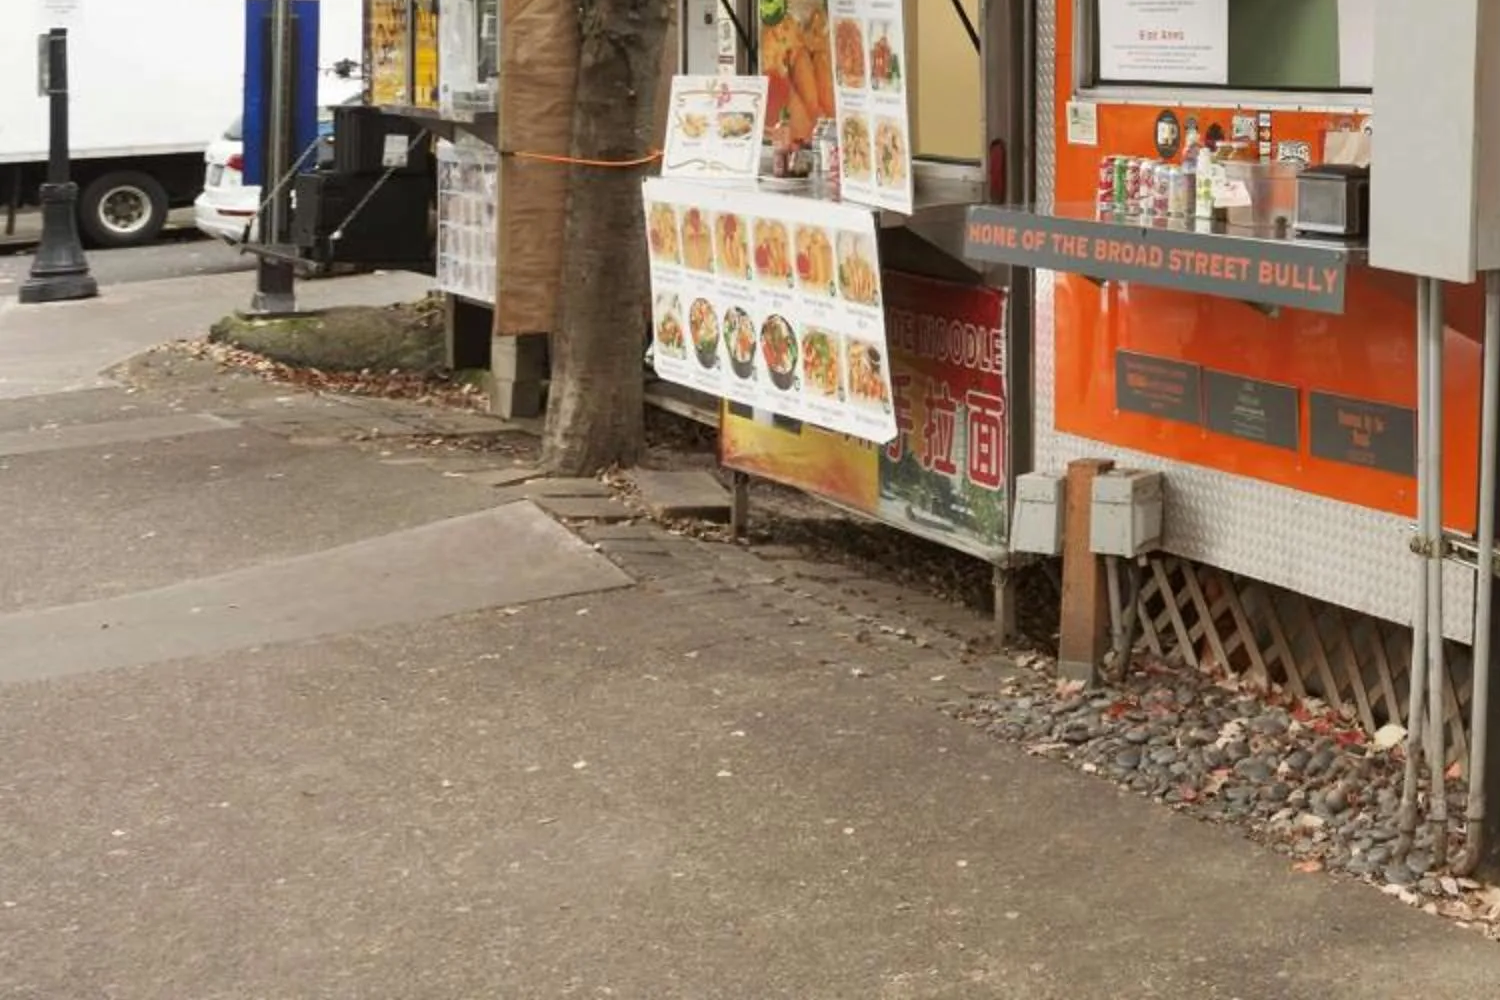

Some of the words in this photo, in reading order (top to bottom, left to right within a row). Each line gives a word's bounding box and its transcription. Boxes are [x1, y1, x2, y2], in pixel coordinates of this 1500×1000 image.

[968, 224, 1017, 250] HOME
[1022, 230, 1046, 253] OF
[1052, 234, 1088, 258] THE
[1095, 239, 1163, 268] BROAD
[1168, 248, 1250, 281] STREET
[1258, 261, 1339, 294] BULLY
